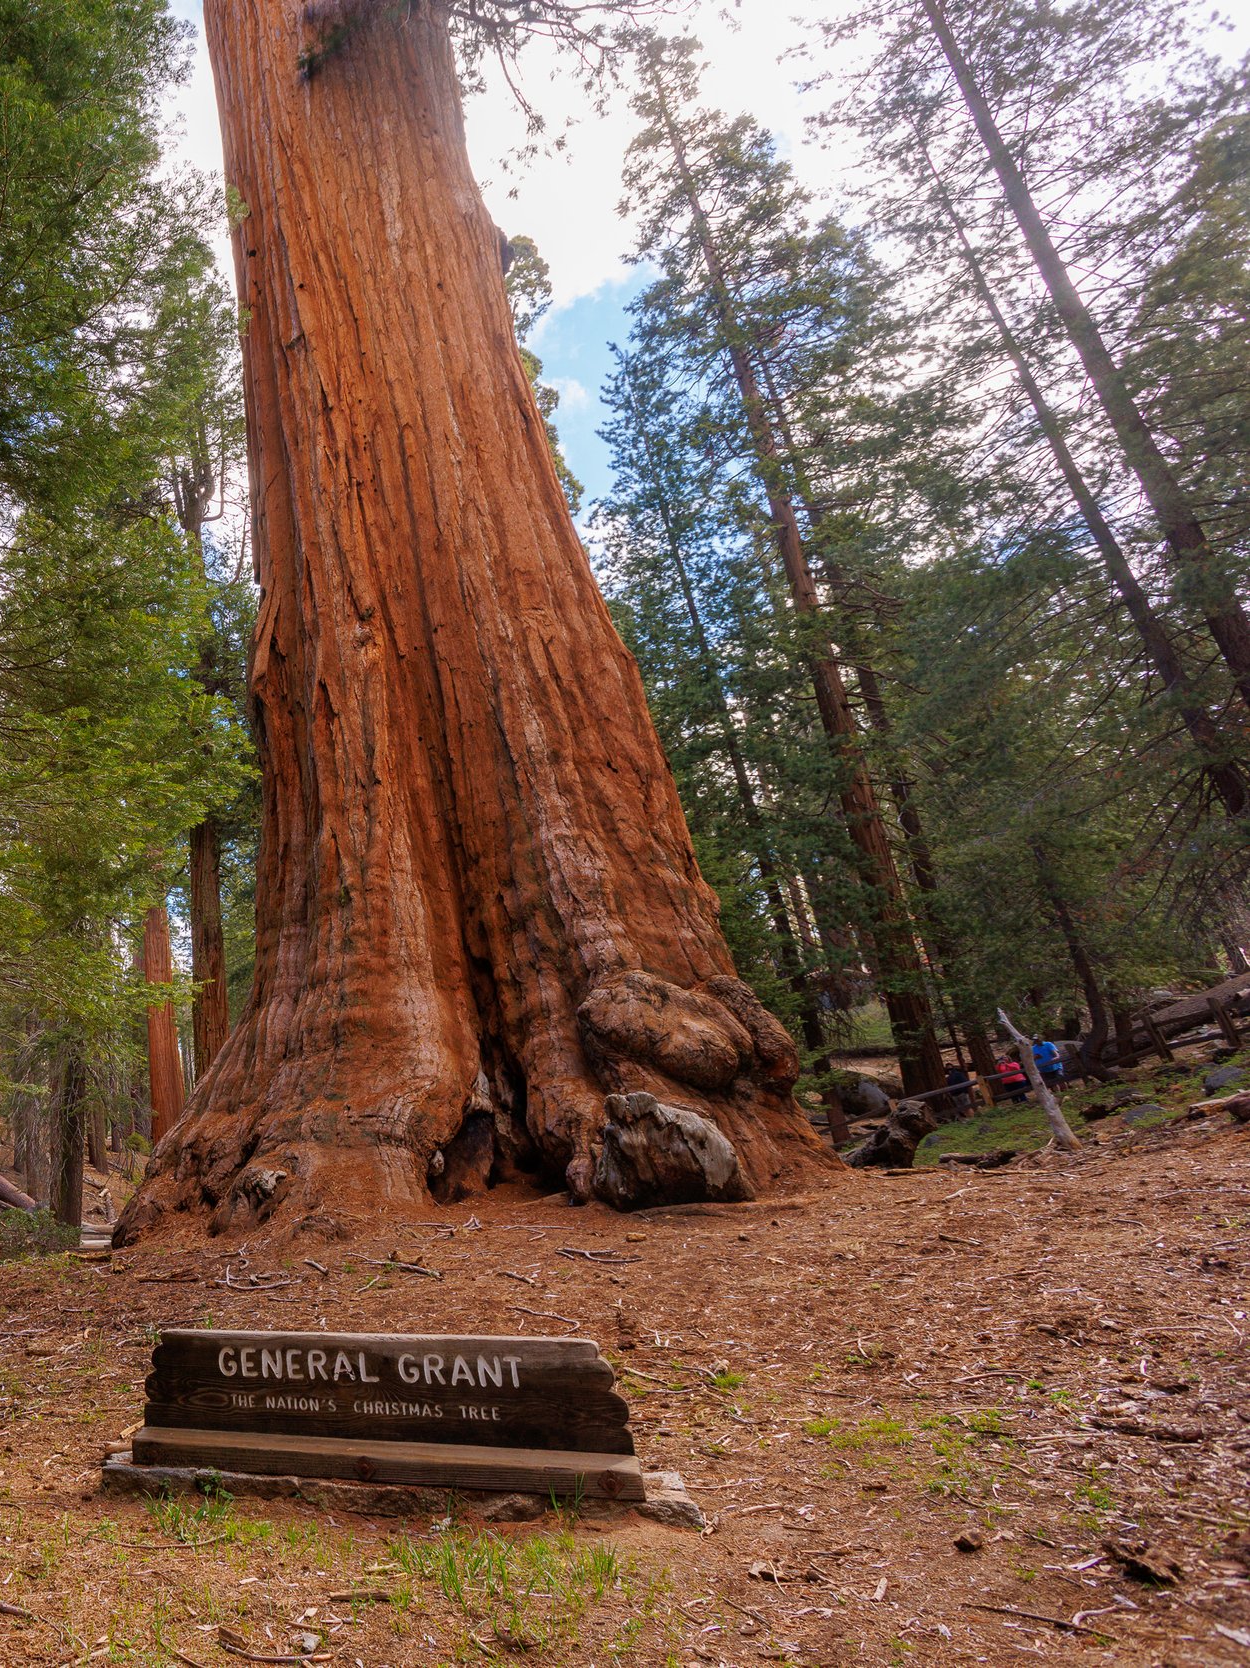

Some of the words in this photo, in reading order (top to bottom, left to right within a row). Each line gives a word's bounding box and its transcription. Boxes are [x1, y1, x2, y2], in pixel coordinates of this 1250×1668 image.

[217, 1346, 380, 1383] GENERAL
[397, 1353, 523, 1388] GRANT
[230, 1393, 256, 1408] THE
[265, 1395, 338, 1413] NATION'S
[353, 1400, 444, 1418] CHRISTMAS
[459, 1405, 502, 1421] TREE
